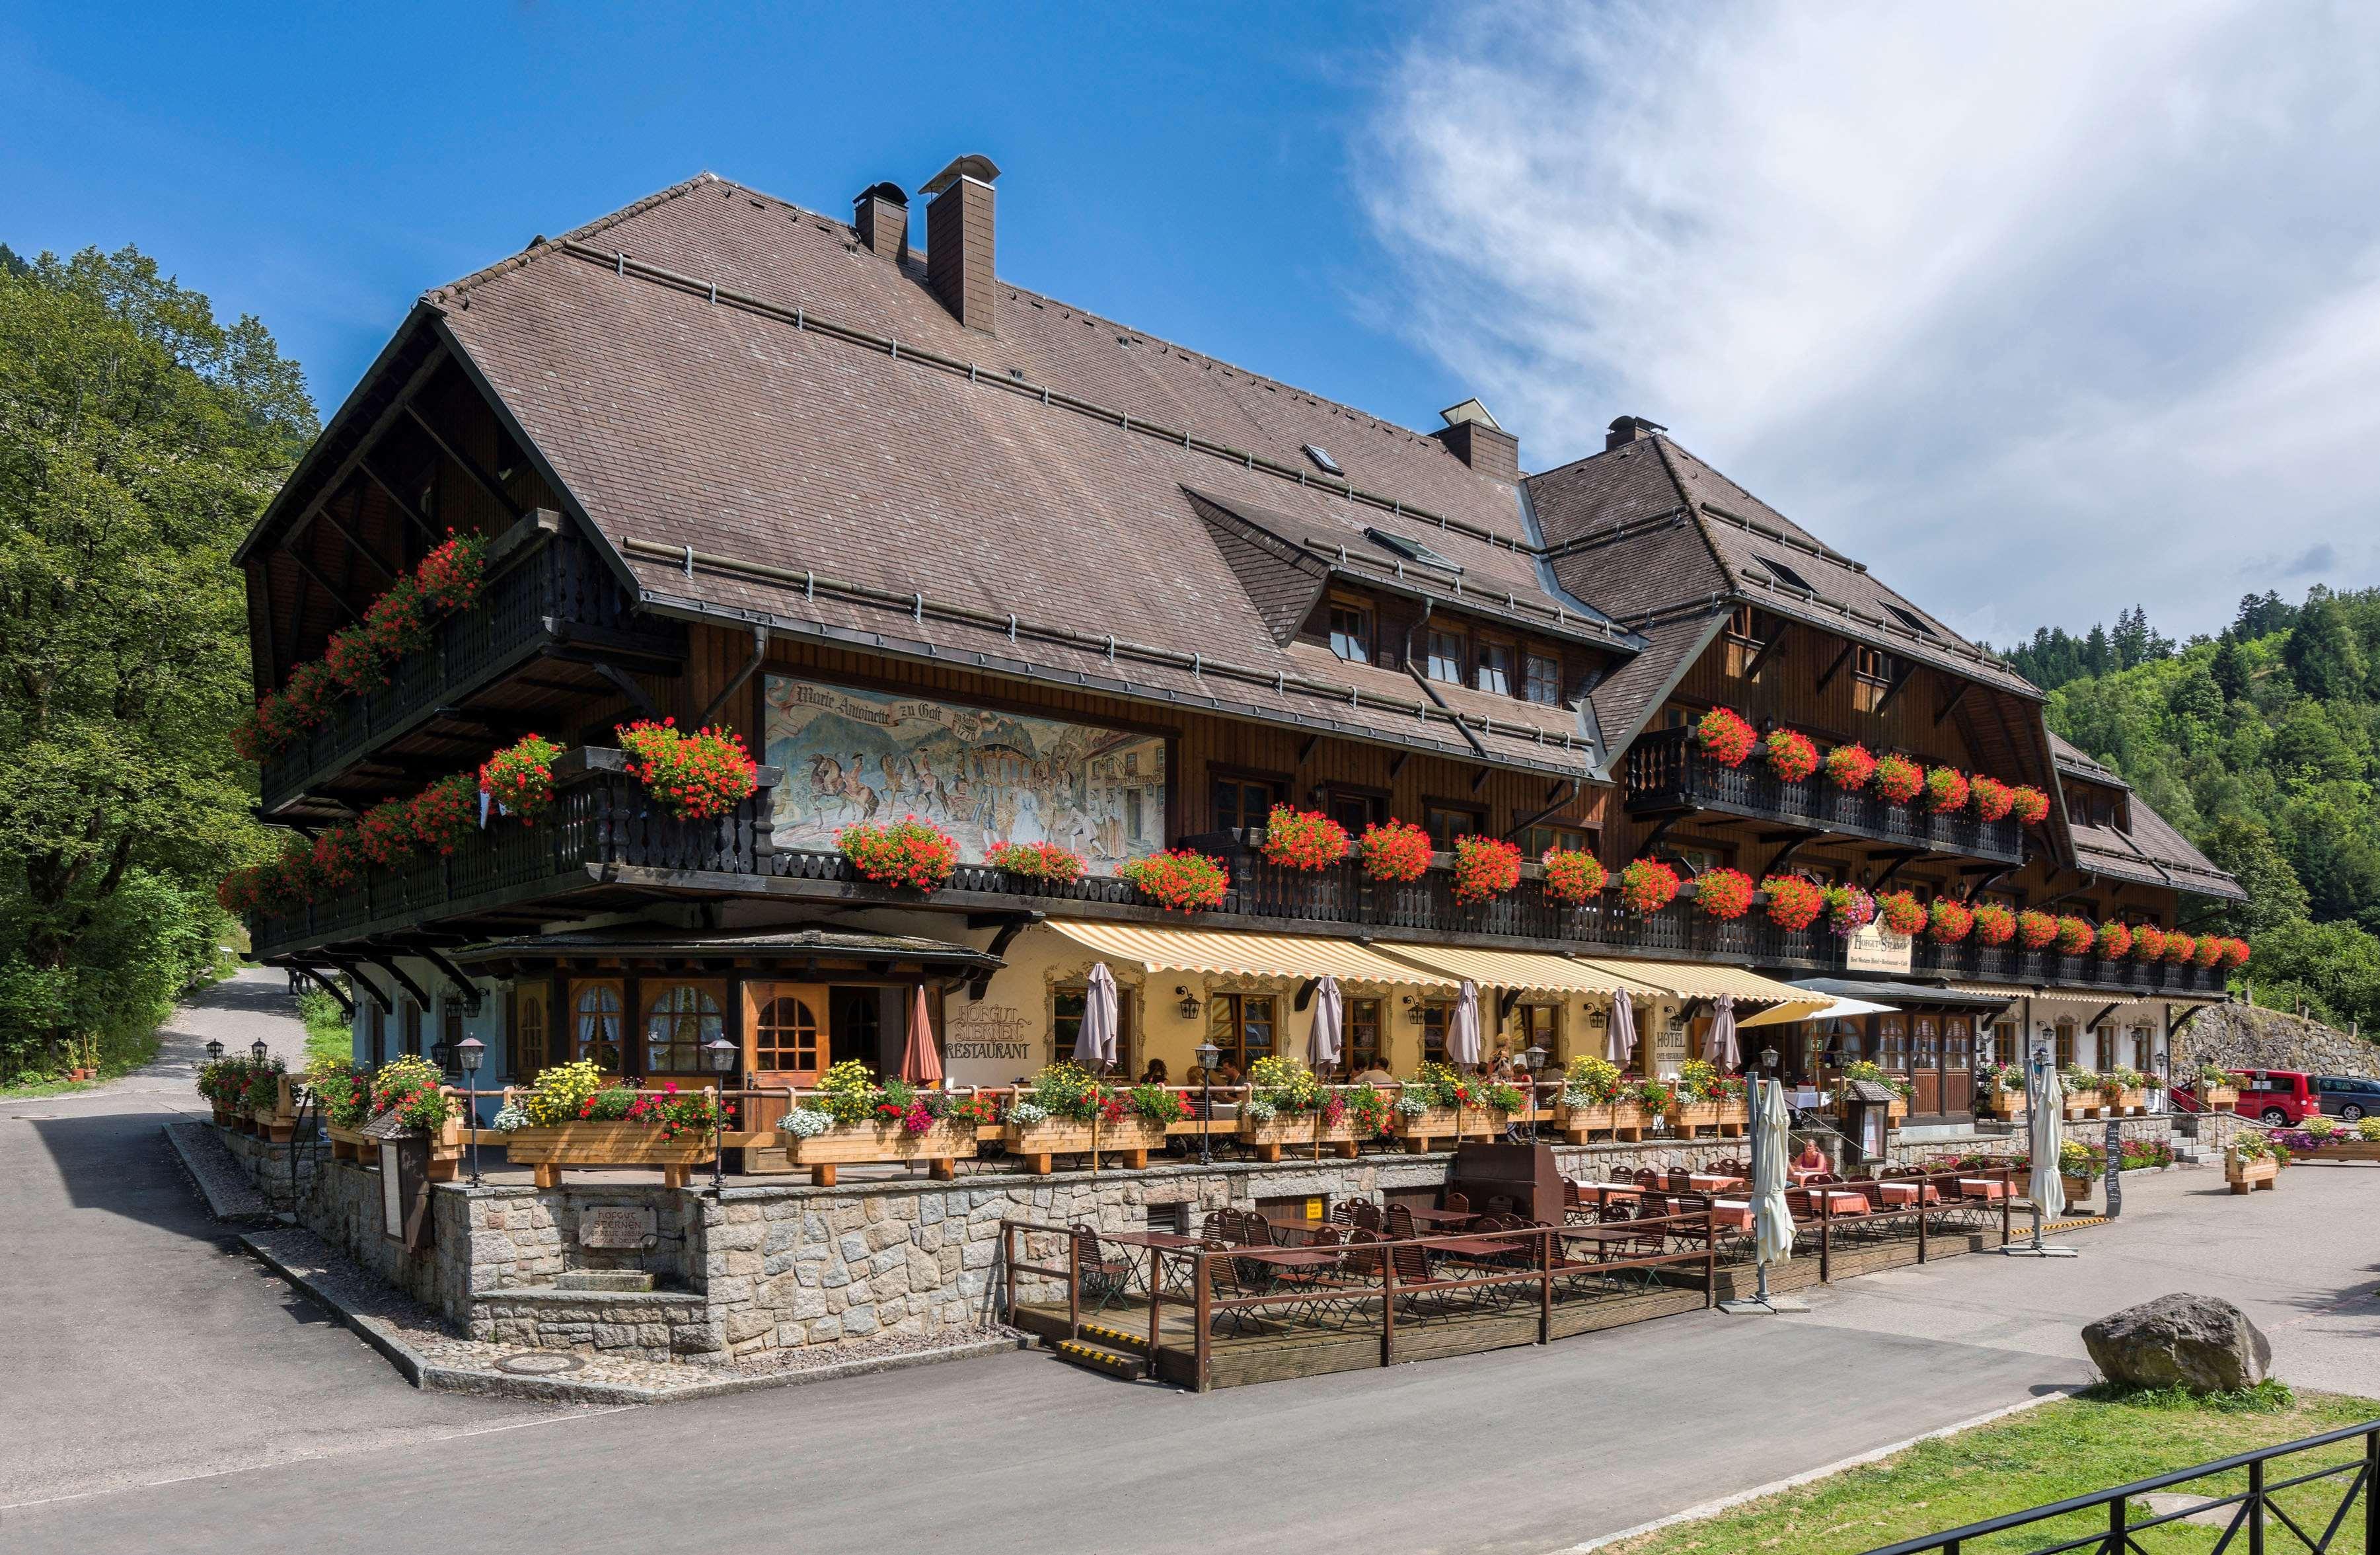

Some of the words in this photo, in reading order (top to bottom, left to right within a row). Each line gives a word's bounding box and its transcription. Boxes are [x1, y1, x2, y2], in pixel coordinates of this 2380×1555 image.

[797, 685, 835, 708] Marie
[835, 697, 890, 725] Antoinette
[899, 704, 916, 717] zu
[956, 725, 977, 741] 1770
[1854, 934, 1880, 950] HOFGUT
[958, 1003, 1019, 1023] HOFGUT
[955, 1022, 1025, 1042] STERNEN
[1656, 1032, 1686, 1047] HOTEL
[945, 1043, 1031, 1059] RESTAURANT
[593, 1220, 641, 1229] STERNEN
